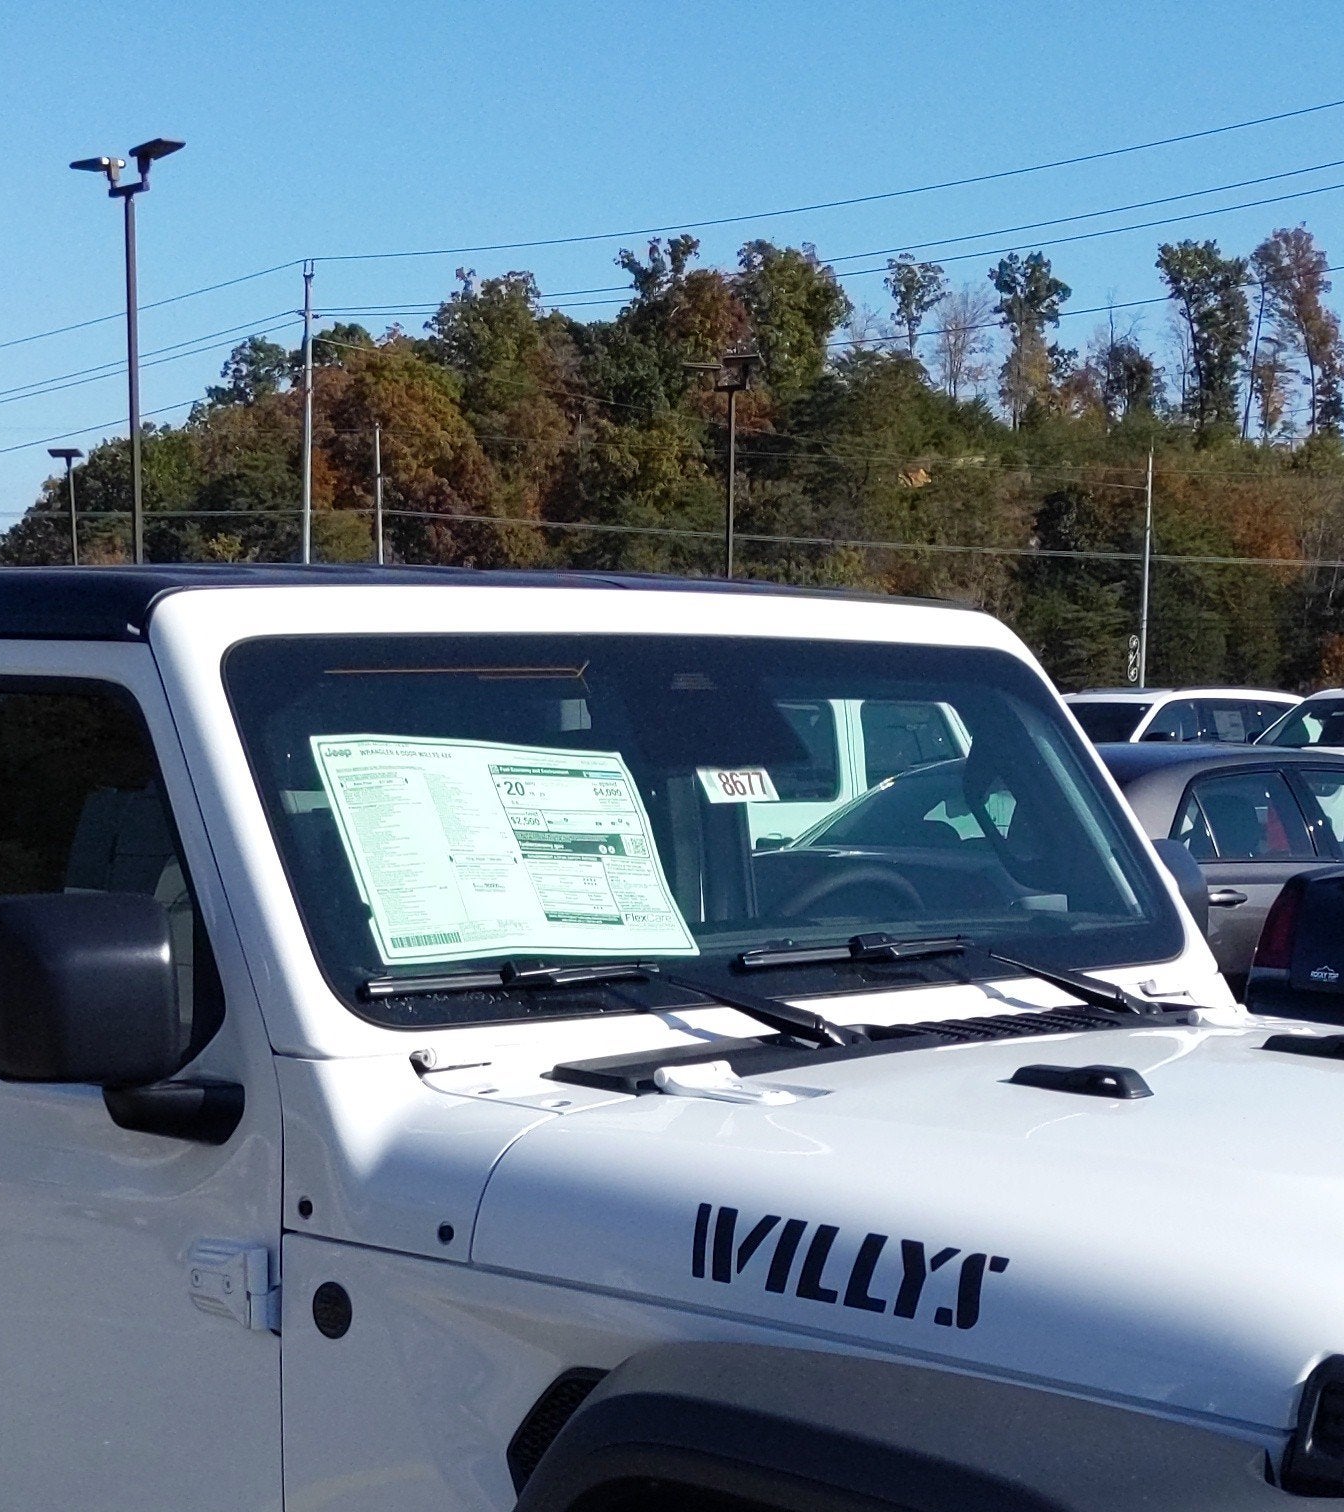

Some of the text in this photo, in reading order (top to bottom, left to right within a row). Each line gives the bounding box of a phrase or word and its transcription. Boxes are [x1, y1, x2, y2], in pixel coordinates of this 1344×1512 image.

[324, 748, 352, 758] Jeep
[503, 781, 525, 796] 20
[717, 771, 768, 796] 8677
[624, 912, 672, 922] FlexCare
[691, 1202, 1010, 1330] WILLYS
